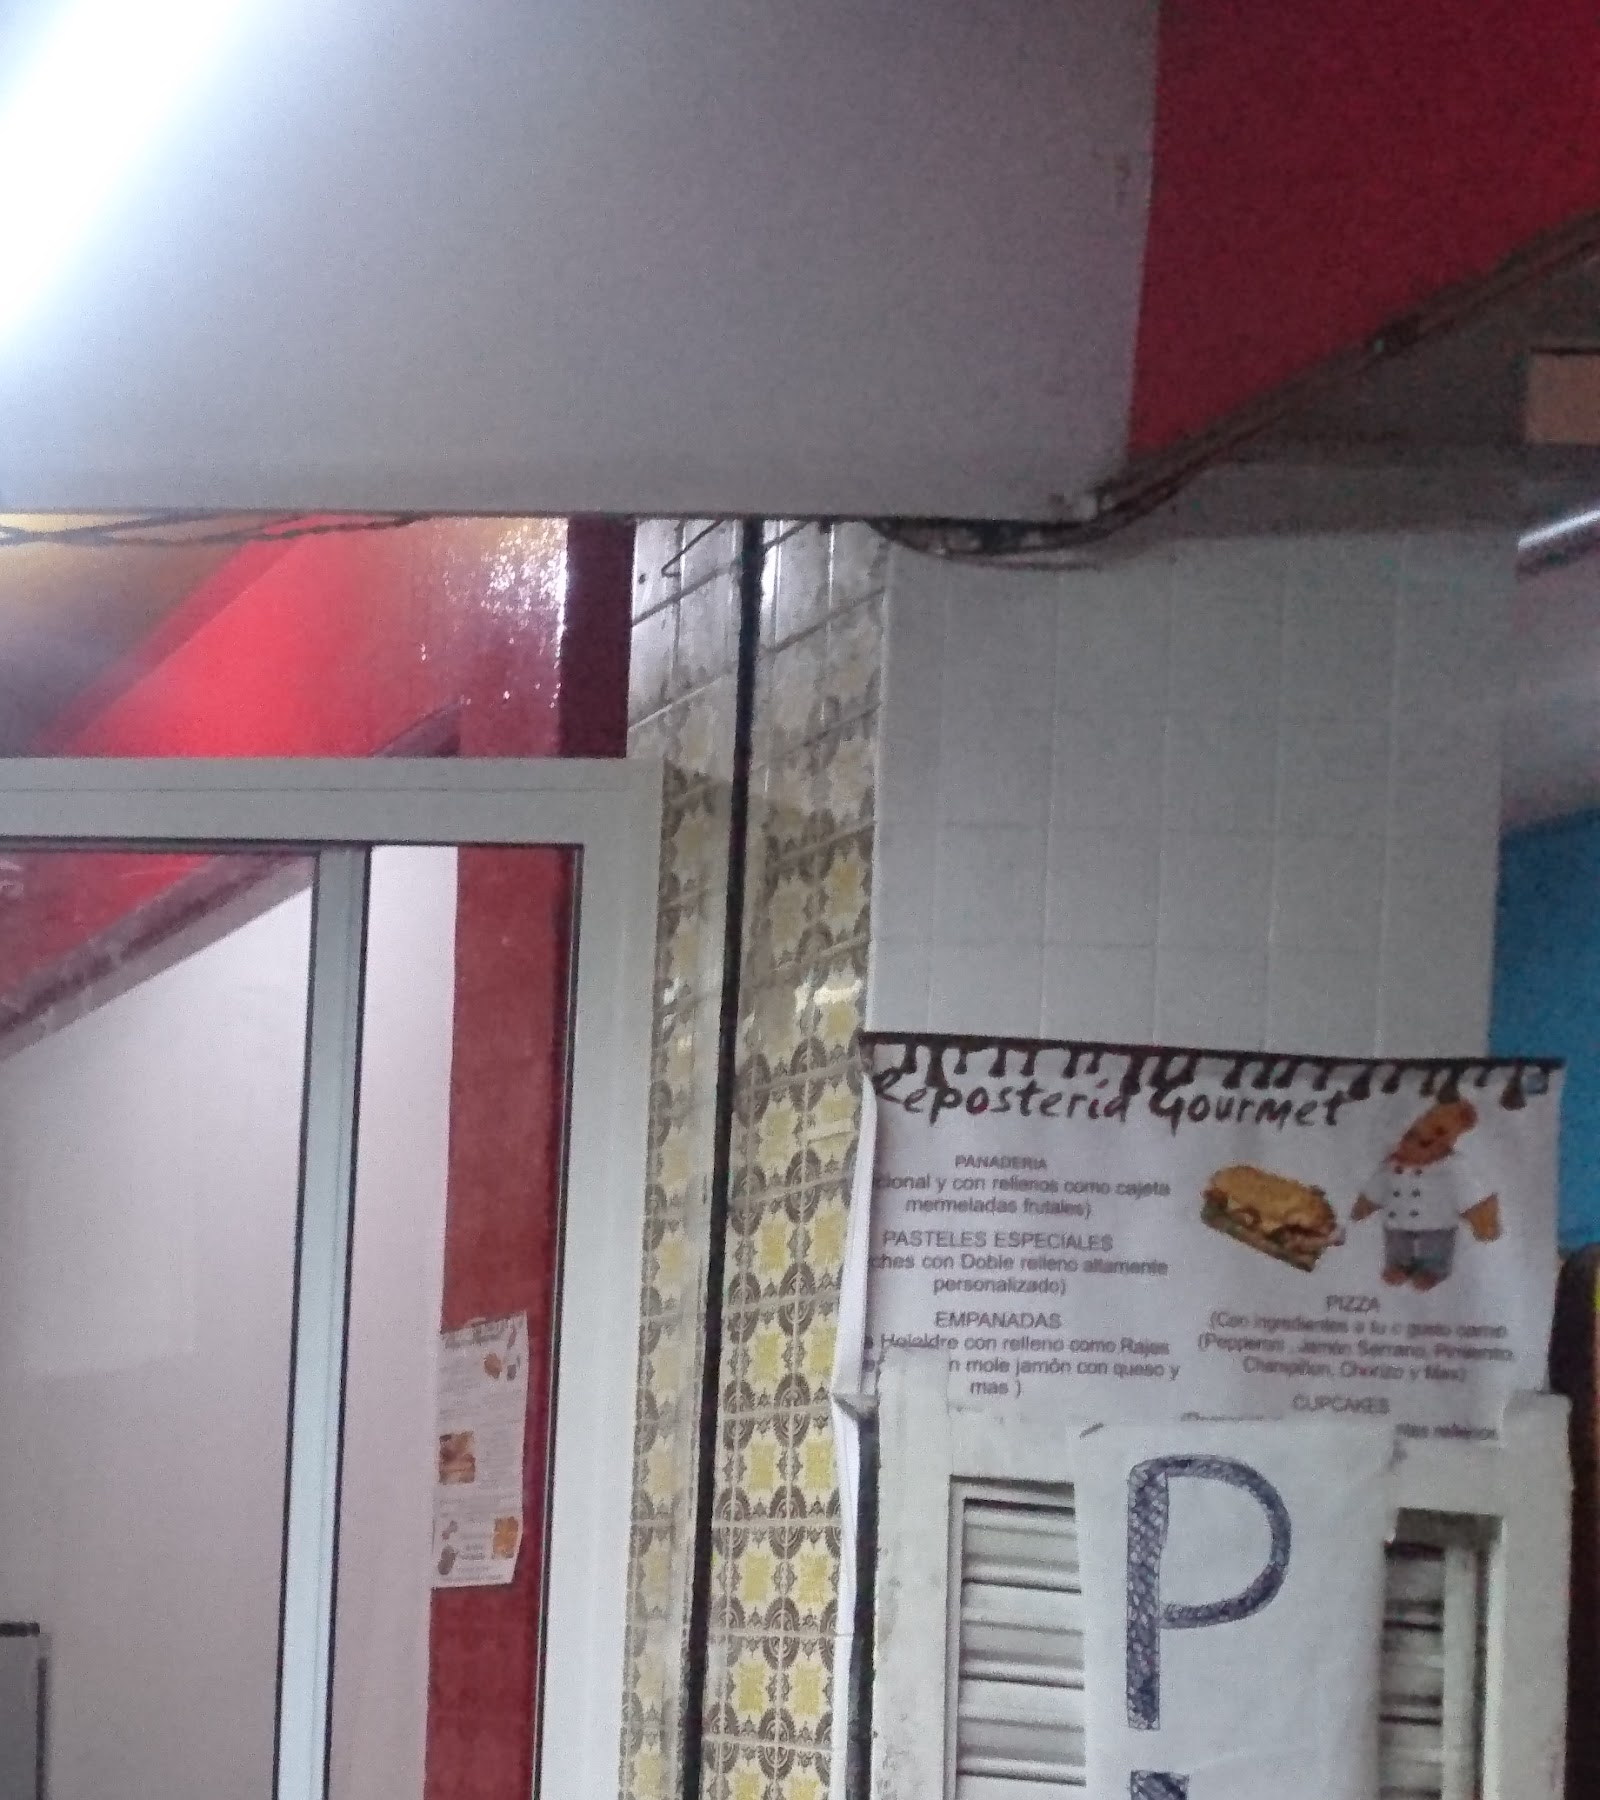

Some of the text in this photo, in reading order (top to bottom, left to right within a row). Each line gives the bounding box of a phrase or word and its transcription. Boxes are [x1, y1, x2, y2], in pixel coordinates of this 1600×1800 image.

[1148, 1085, 1356, 1138] Gourmet
[936, 1177, 947, 1193] y
[953, 1178, 985, 1190] con
[883, 1230, 1114, 1251] PASTELES ESPECIALES
[921, 1256, 954, 1269] con
[961, 1253, 1014, 1270] Doble
[935, 1311, 1062, 1329] EMPANADAS
[964, 1337, 997, 1350] con
[1003, 1336, 1064, 1351] relleno
[1069, 1339, 1116, 1353] como
[1076, 1362, 1108, 1374] con
[1169, 1365, 1180, 1382] y
